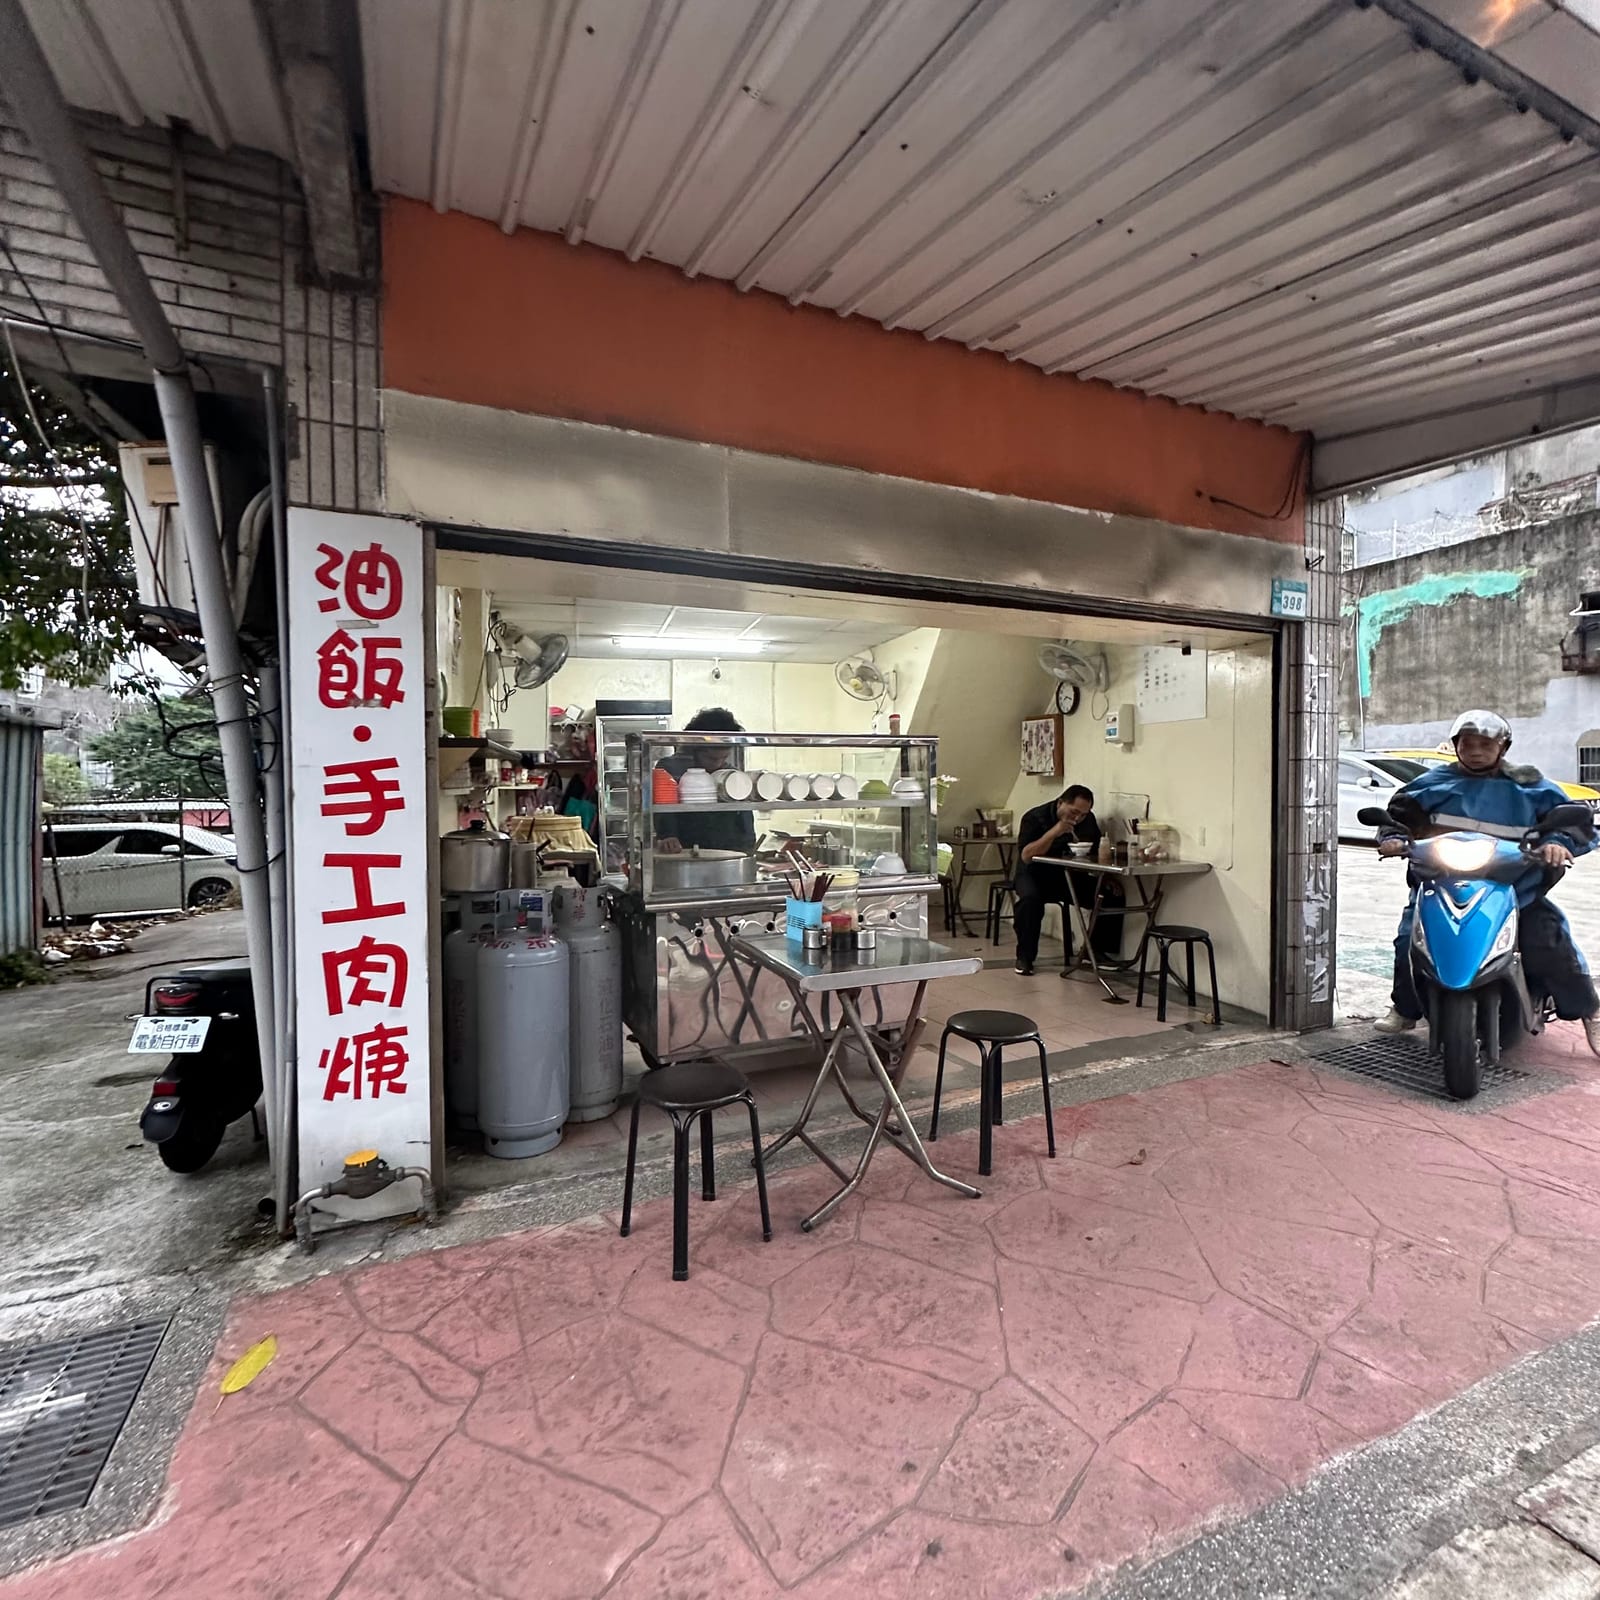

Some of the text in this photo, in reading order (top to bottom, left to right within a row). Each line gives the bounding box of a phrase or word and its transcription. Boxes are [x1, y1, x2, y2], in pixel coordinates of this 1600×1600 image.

[1284, 596, 1302, 611] 398
[136, 1034, 201, 1049] 電動自行車
